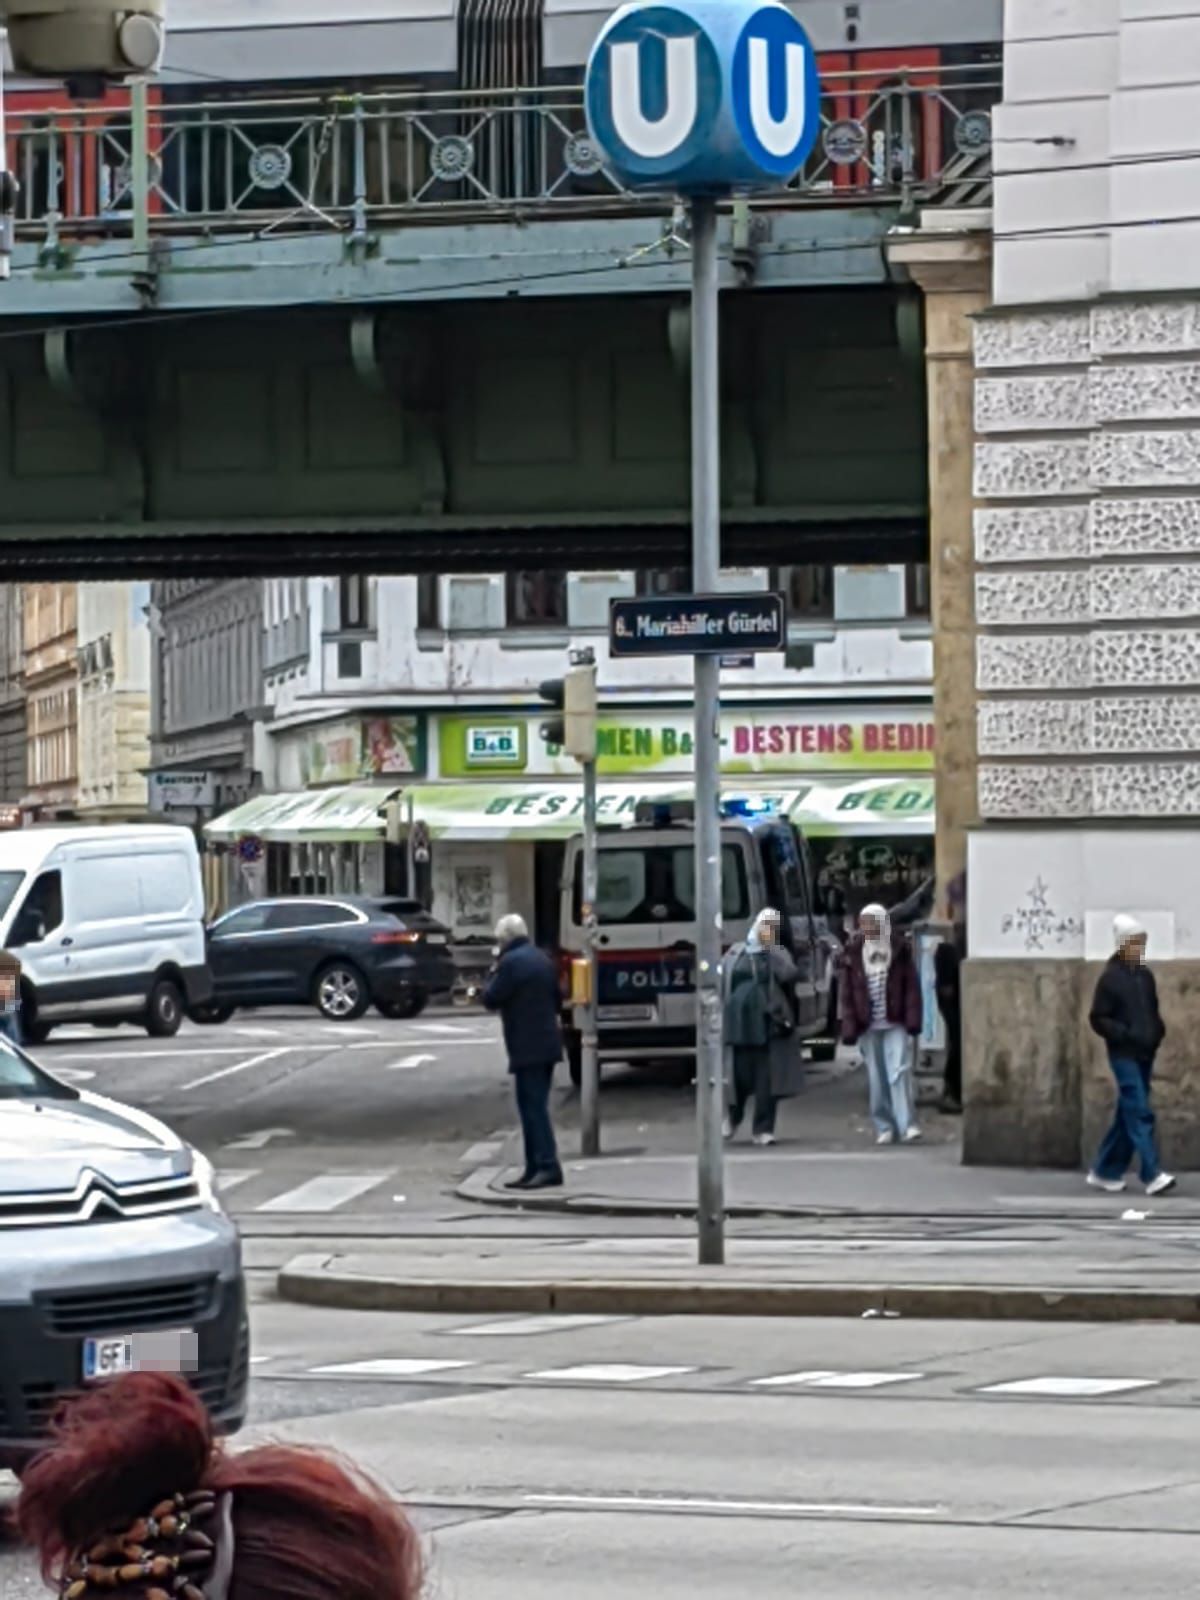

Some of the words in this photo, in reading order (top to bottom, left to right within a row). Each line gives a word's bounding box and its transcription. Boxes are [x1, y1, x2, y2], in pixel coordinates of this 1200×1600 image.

[611, 37, 697, 158] U
[748, 37, 805, 157] U
[636, 612, 725, 637] Mariahilfer
[727, 609, 778, 633] Gürtel
[473, 737, 513, 751] B&B
[733, 724, 855, 755] BESTENS
[616, 967, 696, 988] POLIZ
